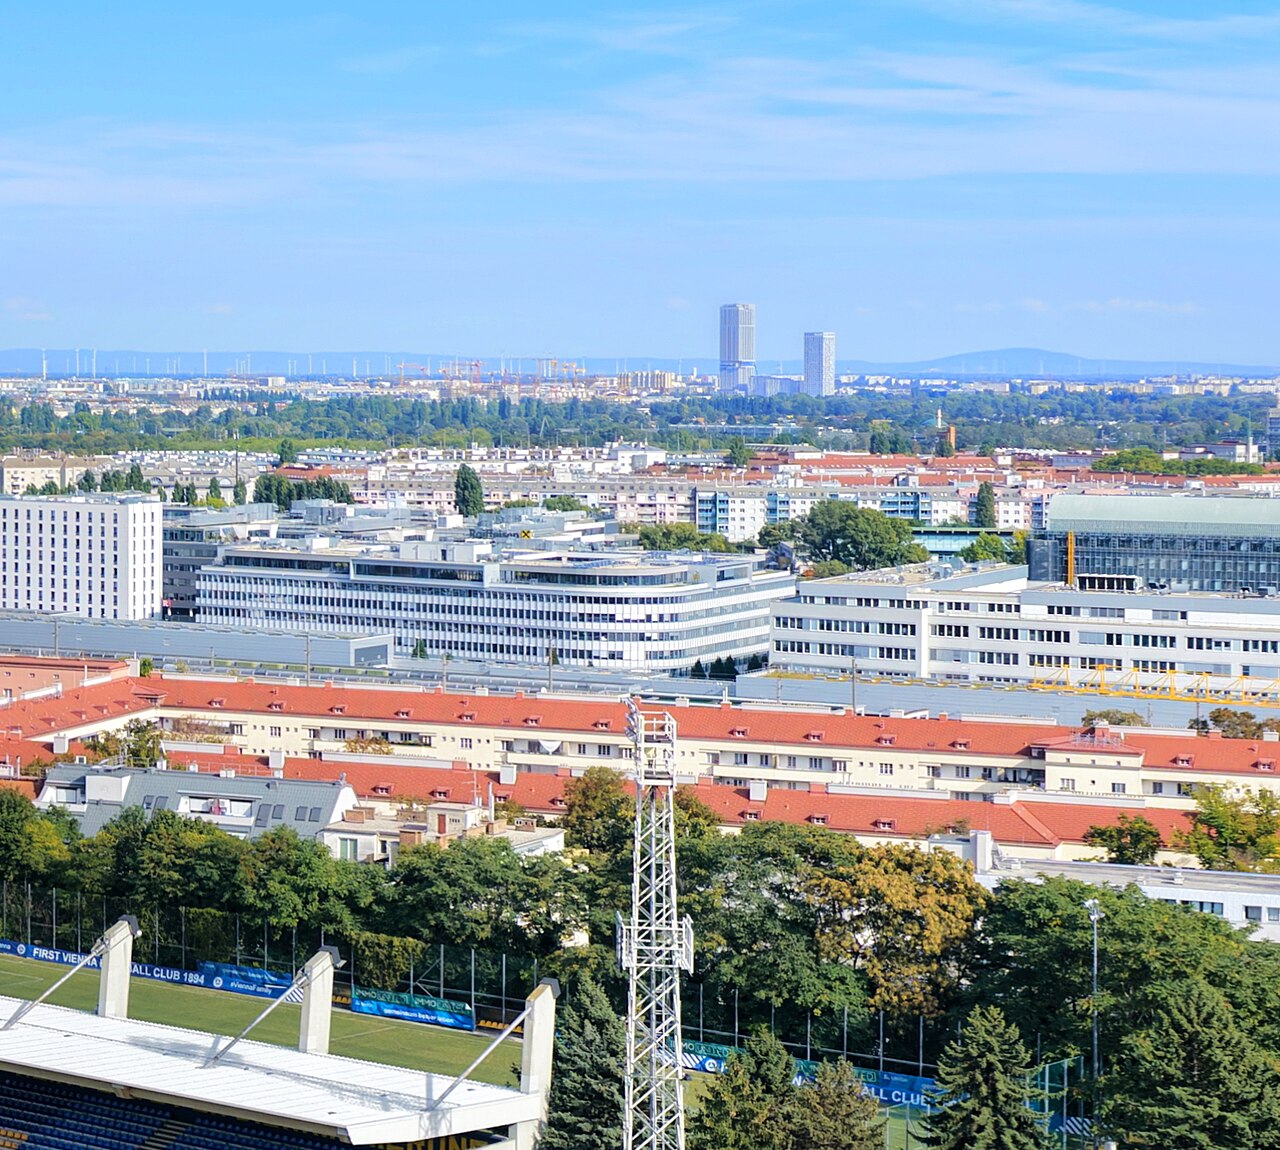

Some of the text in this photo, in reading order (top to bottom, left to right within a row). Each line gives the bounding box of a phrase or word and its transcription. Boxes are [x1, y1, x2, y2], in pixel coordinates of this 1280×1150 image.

[32, 947, 60, 962] FIRST
[153, 967, 181, 981] CLUB
[183, 972, 205, 985] 1894
